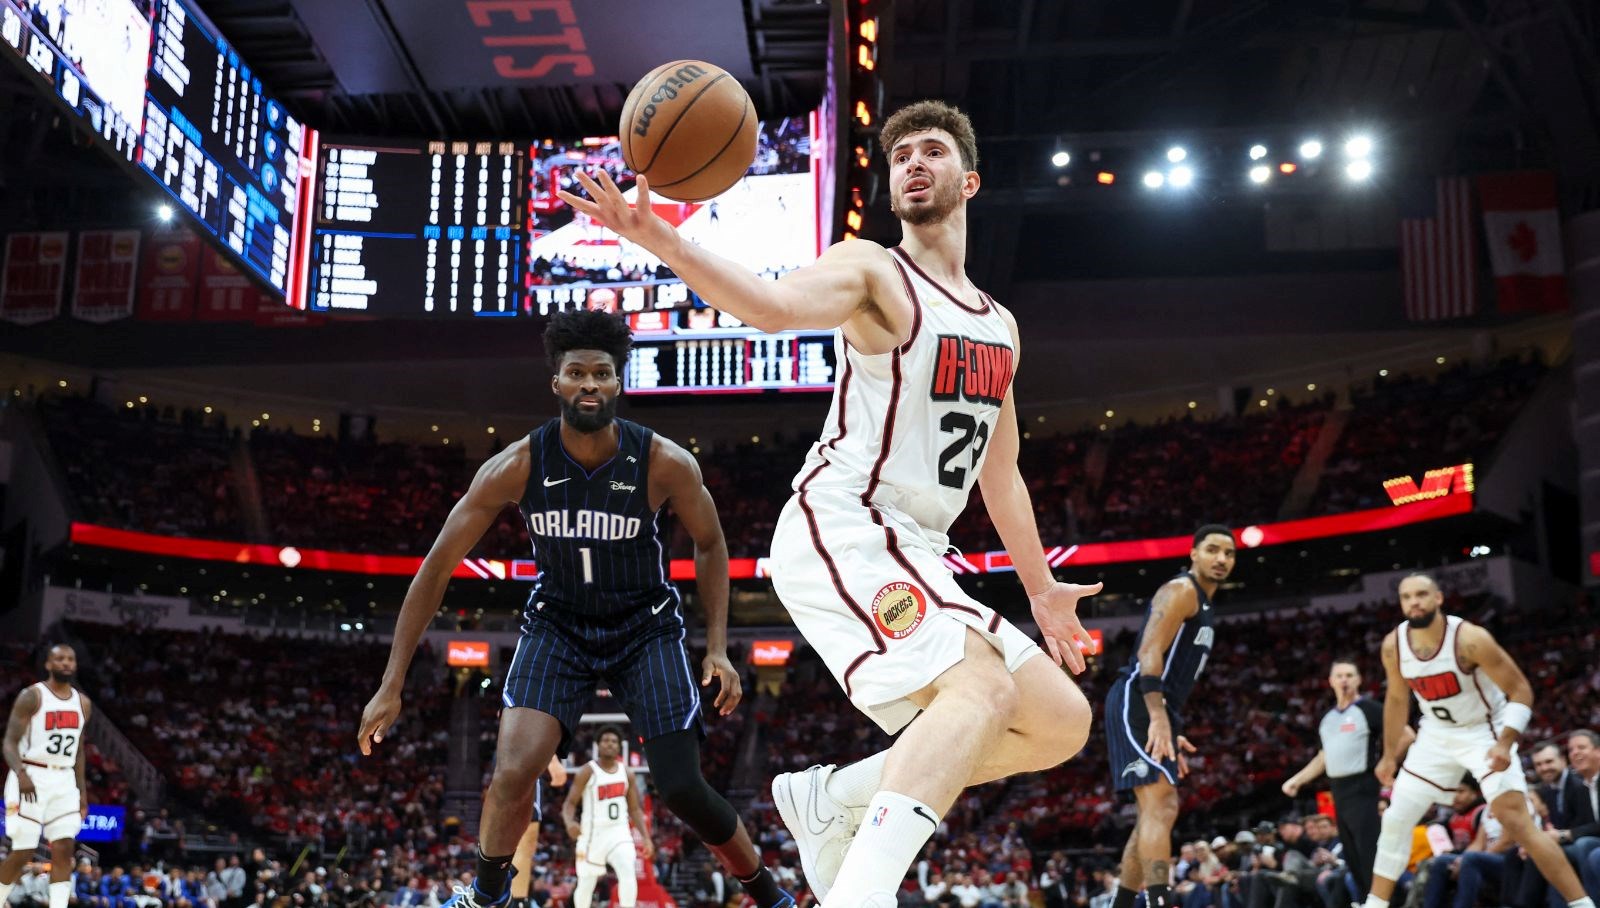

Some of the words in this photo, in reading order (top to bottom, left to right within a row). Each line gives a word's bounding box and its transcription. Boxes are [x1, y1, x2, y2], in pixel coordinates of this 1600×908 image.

[634, 64, 708, 137] Wilson
[609, 480, 636, 493] Disney
[530, 509, 641, 541] ORLANDO
[579, 547, 593, 583] 1
[873, 583, 911, 614] HOUSTON
[883, 595, 914, 625] ROCKETS
[893, 611, 923, 638] SUMMIT
[46, 734, 75, 756] 32
[608, 803, 618, 820] 0
